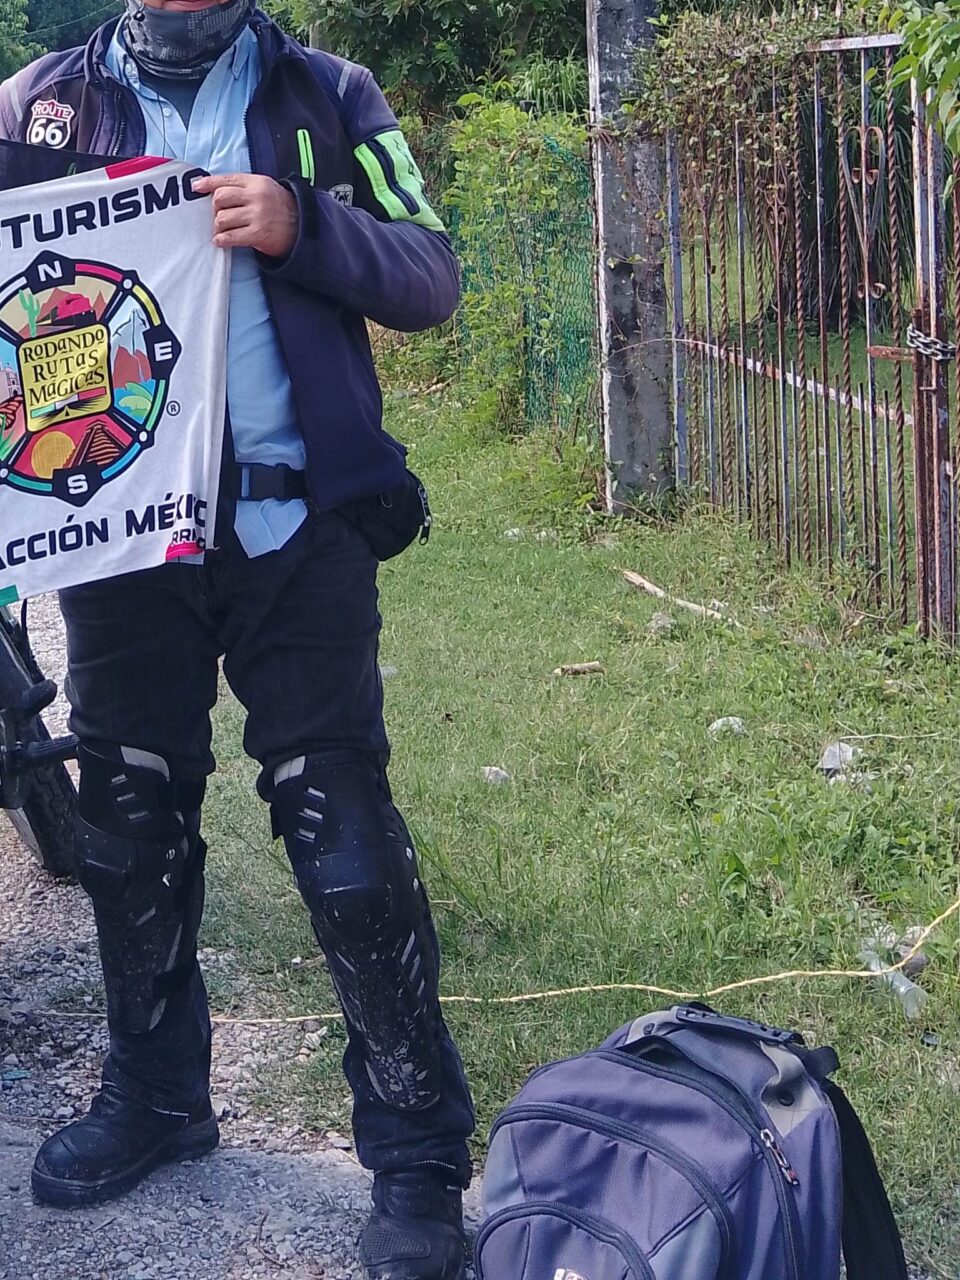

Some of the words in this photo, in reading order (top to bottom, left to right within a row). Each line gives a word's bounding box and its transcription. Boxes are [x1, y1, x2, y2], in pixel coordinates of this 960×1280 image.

[34, 104, 71, 118] ROUTE
[31, 119, 64, 146] 66
[38, 260, 63, 282] N
[154, 341, 173, 361] E
[66, 474, 88, 494] S
[126, 492, 207, 537] MÉXIC
